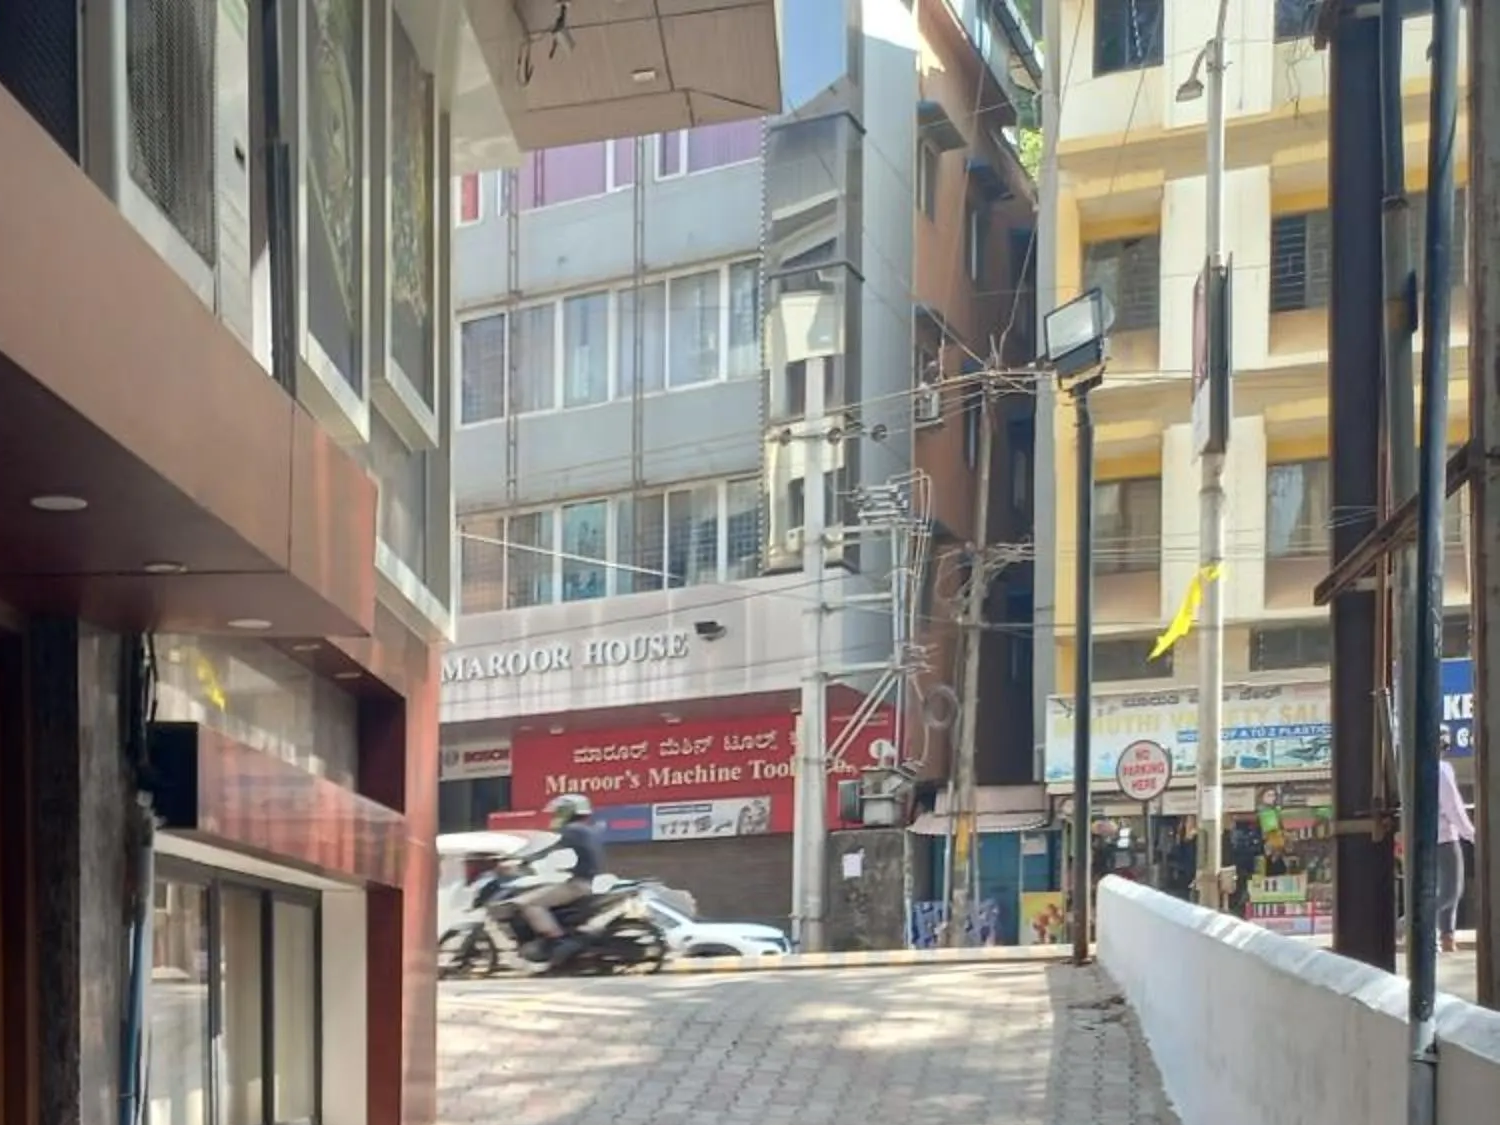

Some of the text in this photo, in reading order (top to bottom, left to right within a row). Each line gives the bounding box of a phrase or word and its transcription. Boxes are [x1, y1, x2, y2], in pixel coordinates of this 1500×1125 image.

[441, 632, 690, 684] MAROOR HOUSE
[545, 770, 641, 795] Maroor's
[648, 763, 743, 788] Machine
[748, 755, 799, 780] Tool
[1123, 762, 1165, 776] PARKING
